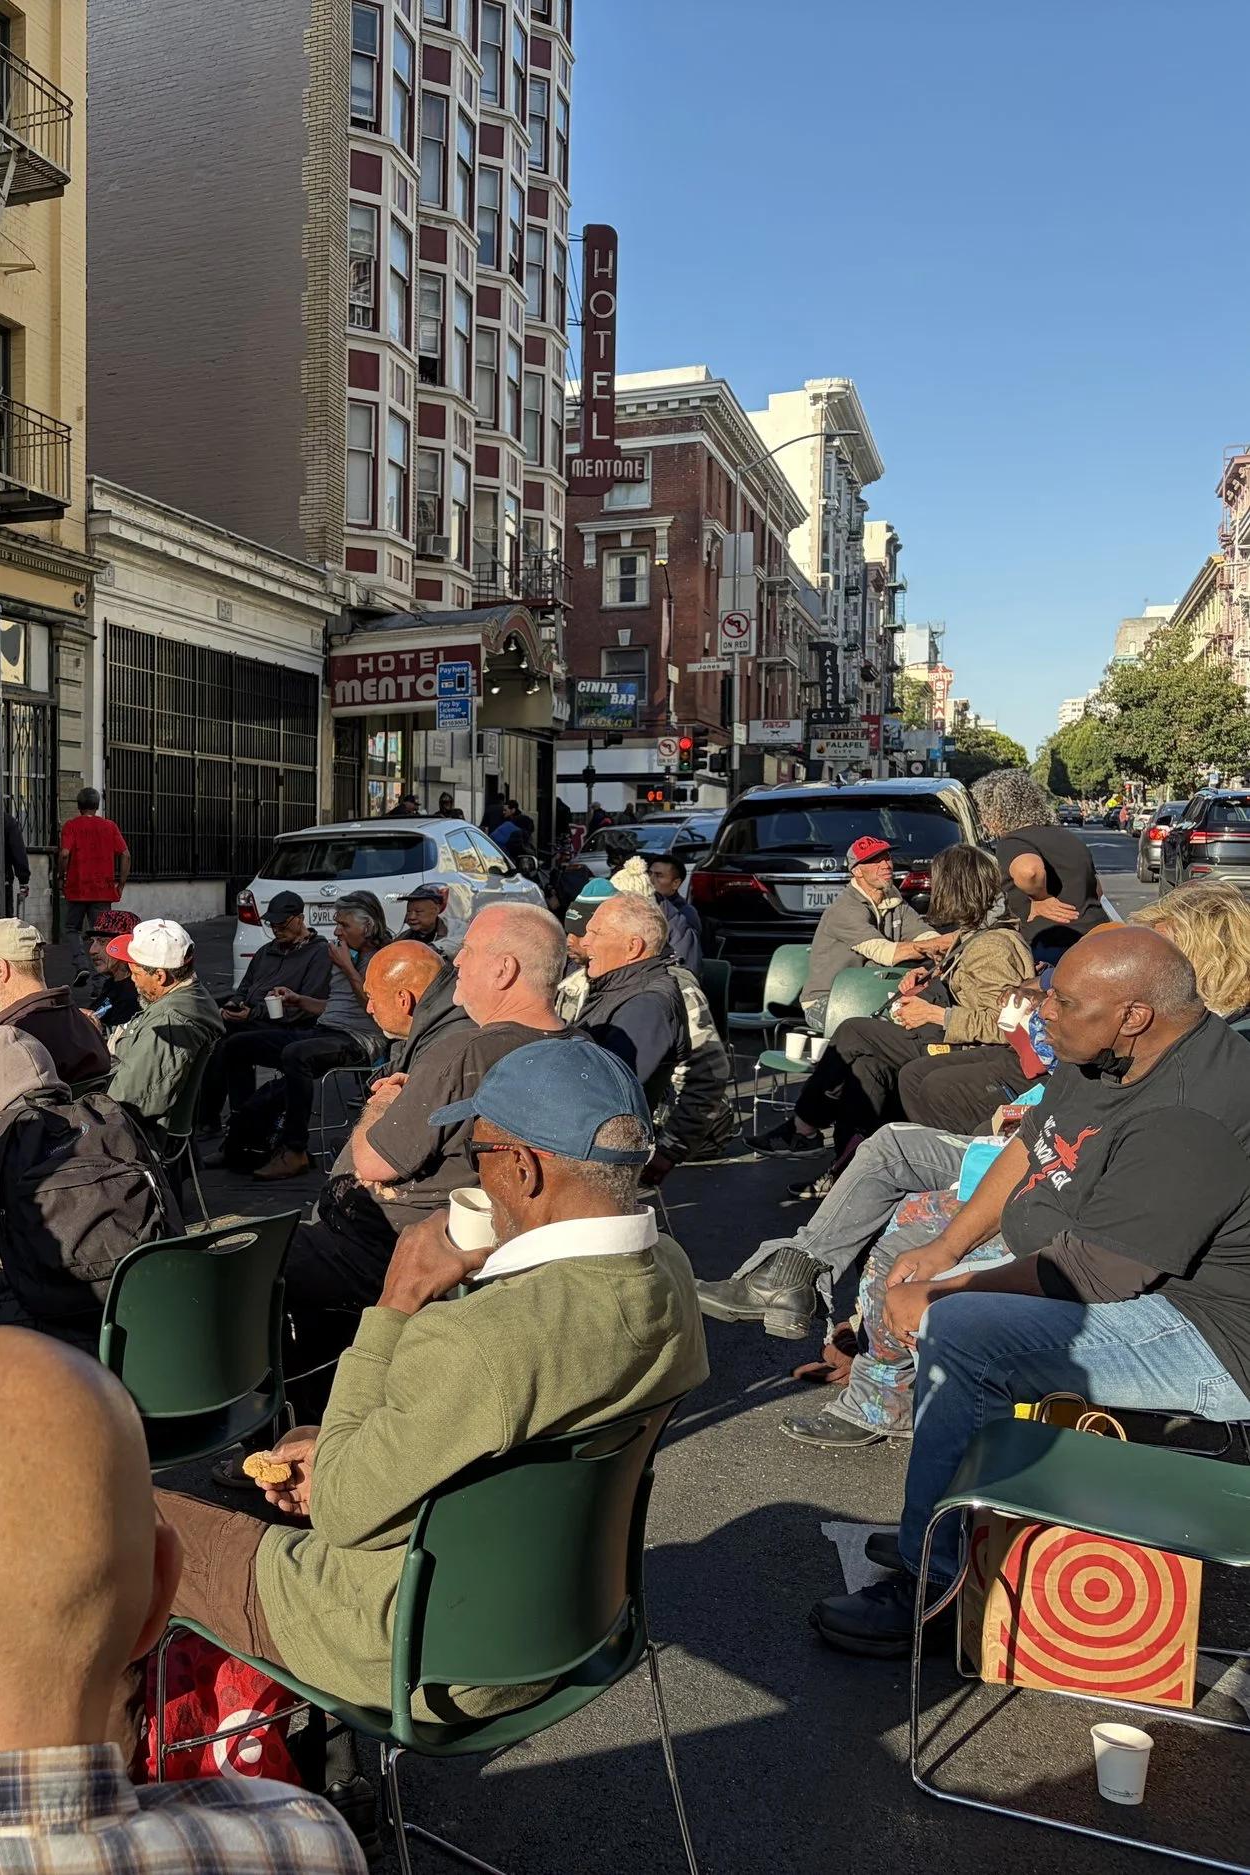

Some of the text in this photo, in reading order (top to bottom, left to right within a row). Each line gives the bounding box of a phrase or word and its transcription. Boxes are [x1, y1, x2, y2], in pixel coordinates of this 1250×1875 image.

[589, 249, 617, 440] HOTEL
[723, 640, 748, 649] ON RED
[697, 663, 721, 671] Jones
[824, 650, 833, 708] FALAFEL
[577, 681, 618, 693] CINNA
[610, 693, 636, 705] BAR
[811, 711, 845, 720] CITY
[826, 741, 865, 749] FALAFEL
